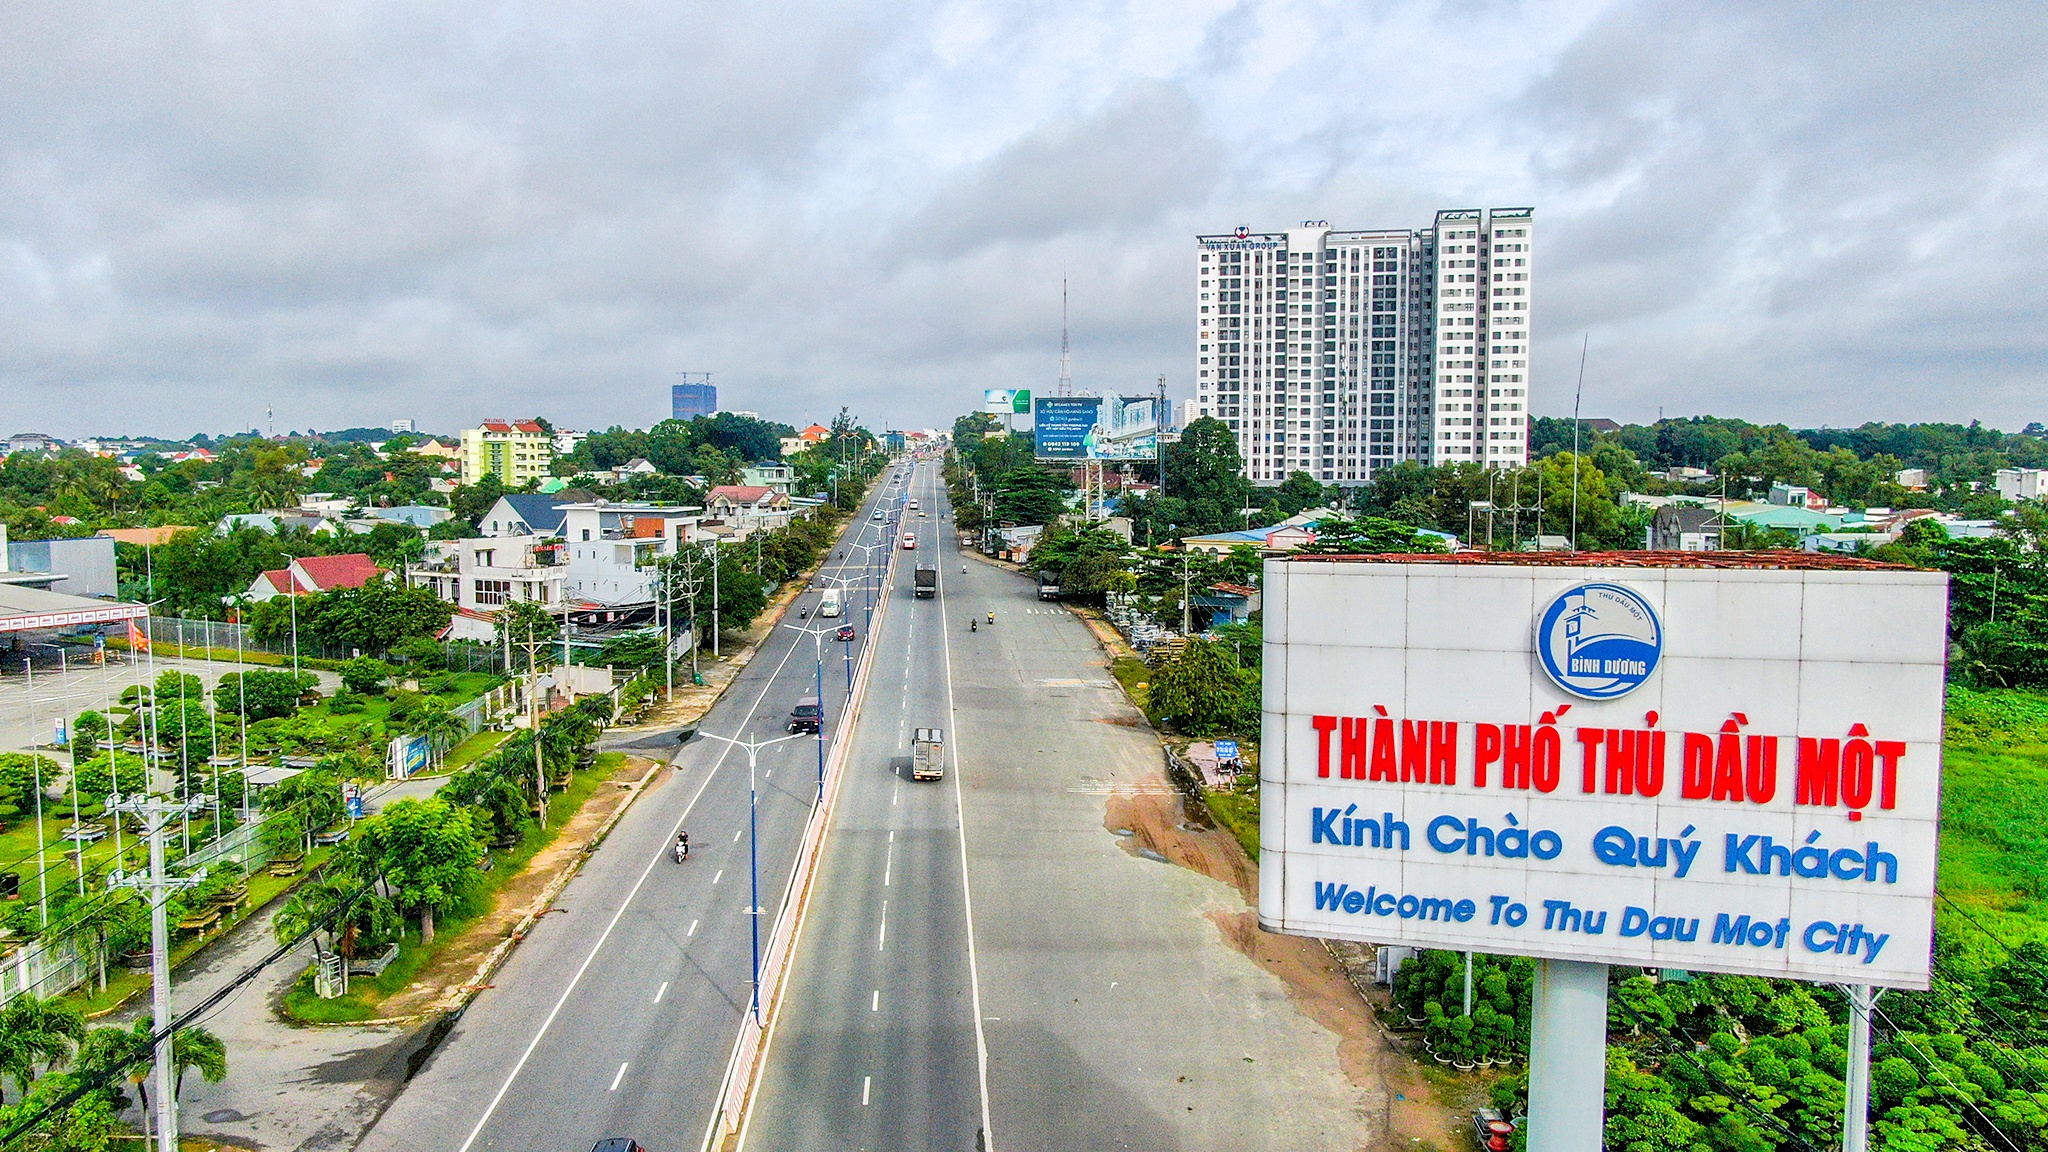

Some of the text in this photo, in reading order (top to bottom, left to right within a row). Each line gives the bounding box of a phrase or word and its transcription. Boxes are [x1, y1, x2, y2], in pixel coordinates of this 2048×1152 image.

[1249, 241, 1278, 250] GROUP
[1598, 592, 1643, 621] THỦ DẦU MỘT
[1572, 656, 1646, 675] BÌNH DƯƠNG
[1312, 704, 1907, 821] THÀNH PHỐ THỦ DẦU MỘT
[1312, 804, 1899, 884] Kính Chào Quý Khách
[1315, 881, 1890, 965] Welcome To Thu Dau Mot City
